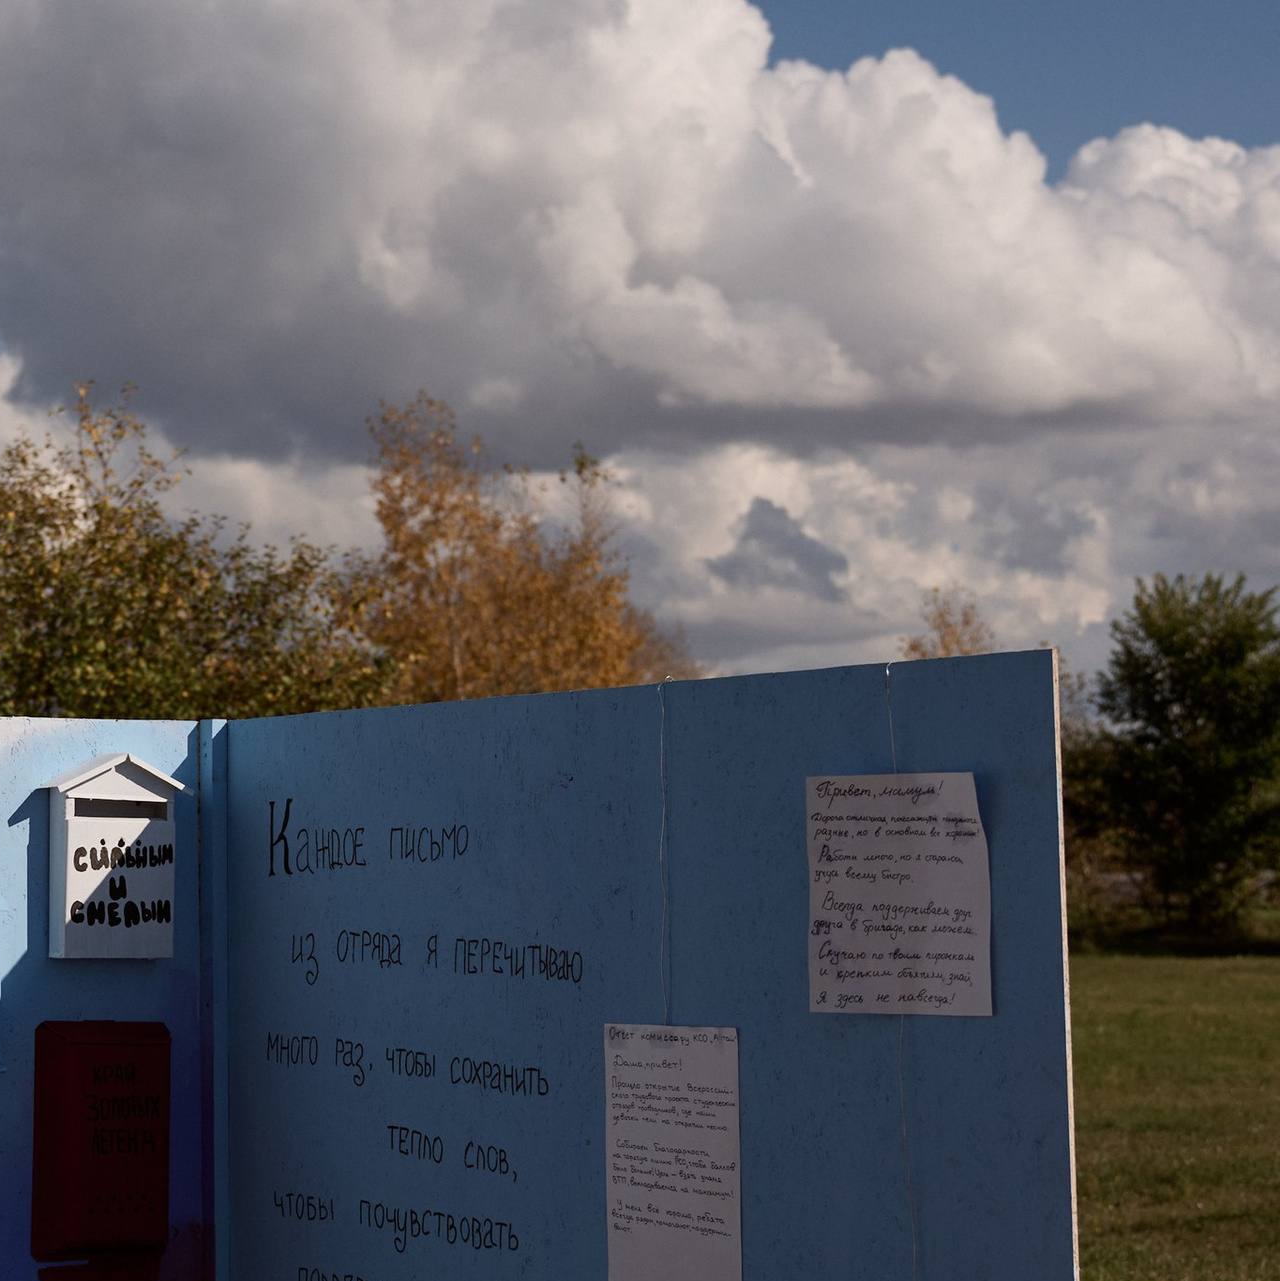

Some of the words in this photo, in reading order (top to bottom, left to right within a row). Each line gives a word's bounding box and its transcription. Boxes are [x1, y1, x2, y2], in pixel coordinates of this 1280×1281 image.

[816, 780, 876, 809] Привет,
[70, 899, 171, 928] СМЕЛЫМ
[821, 890, 865, 920] Всегда
[872, 902, 951, 920] поддерживаем
[818, 940, 867, 965] Скучаю
[837, 992, 864, 1009] здесь
[876, 992, 890, 1003] не
[897, 989, 956, 1009] навсегда!
[92, 1063, 137, 1086] КРАЙ
[84, 1093, 161, 1120] ЗОЛОТЫХ
[90, 1127, 156, 1156] ЛЕГЕНД
